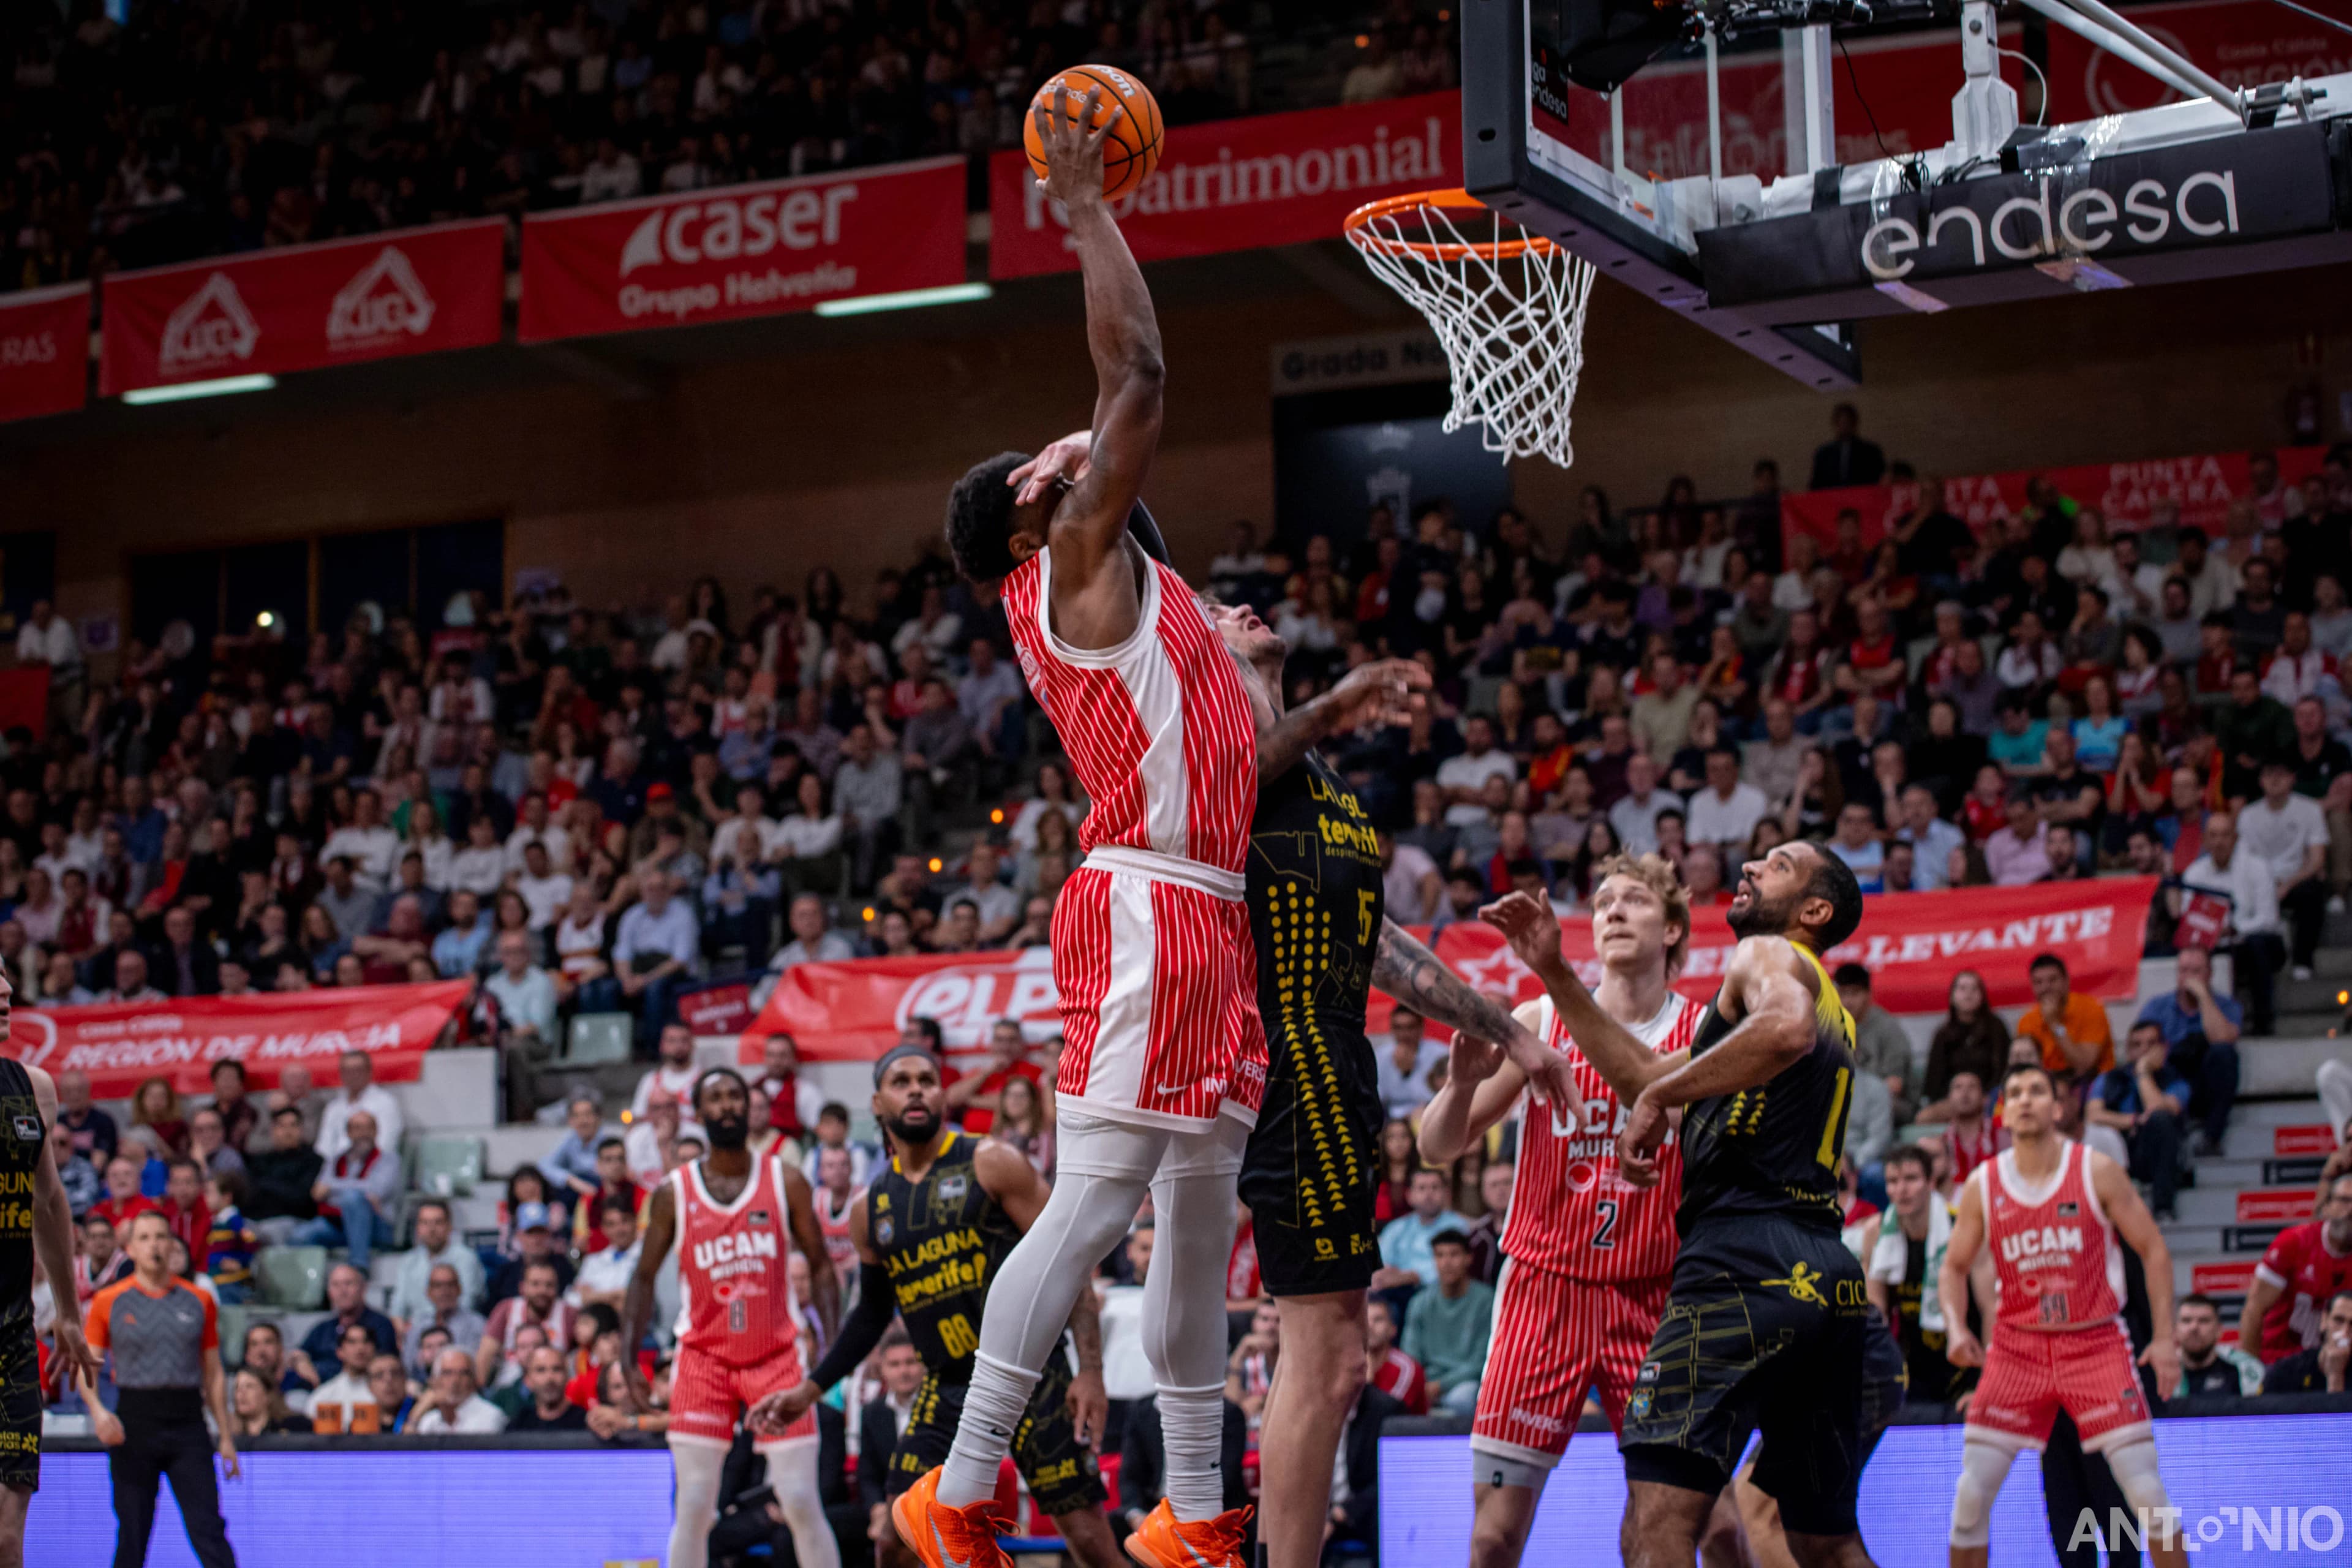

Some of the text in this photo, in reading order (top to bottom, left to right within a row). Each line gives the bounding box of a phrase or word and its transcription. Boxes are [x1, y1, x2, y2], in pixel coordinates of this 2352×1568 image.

[1111, 117, 1443, 220] atrimonial
[665, 186, 859, 263] caser
[1862, 171, 2240, 279] endesa
[619, 284, 718, 320] Grupo
[1863, 906, 2113, 964] LEVANTE
[203, 1032, 256, 1061] DE
[1551, 1098, 1675, 1145] UCA
[902, 1227, 984, 1270] LAGUNA
[1594, 1200, 1618, 1250] 2
[2001, 1226, 2084, 1262] UCAM
[694, 1231, 777, 1270] UCAM
